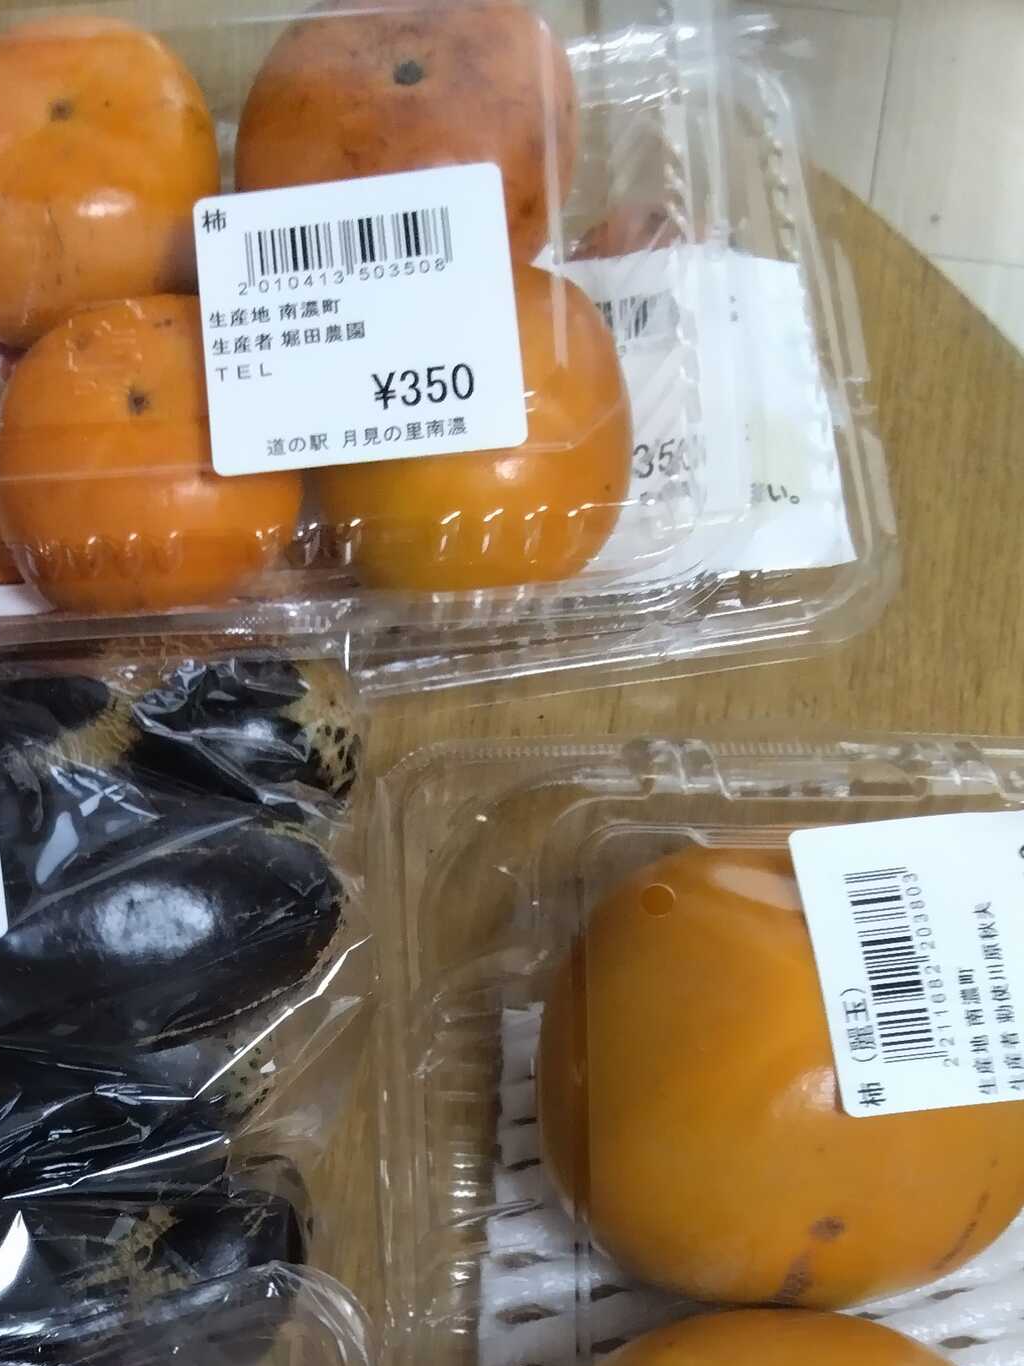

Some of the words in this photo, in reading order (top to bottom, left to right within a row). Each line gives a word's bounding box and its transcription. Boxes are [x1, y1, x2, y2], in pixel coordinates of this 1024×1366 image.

[202, 209, 227, 234] 柿
[259, 271, 345, 293] 010413
[359, 257, 447, 282] 503508
[209, 306, 271, 329] 生産地
[279, 298, 341, 321] 南濃町
[212, 333, 272, 356] 生産者
[281, 321, 366, 348] 堀田農園
[215, 363, 272, 382] TEL
[371, 363, 475, 410] ¥350
[267, 432, 329, 457] 道の駅
[342, 416, 468, 449] 月見の里南濃
[958, 968, 985, 1027] 南濃町
[970, 1034, 998, 1095] 生産地
